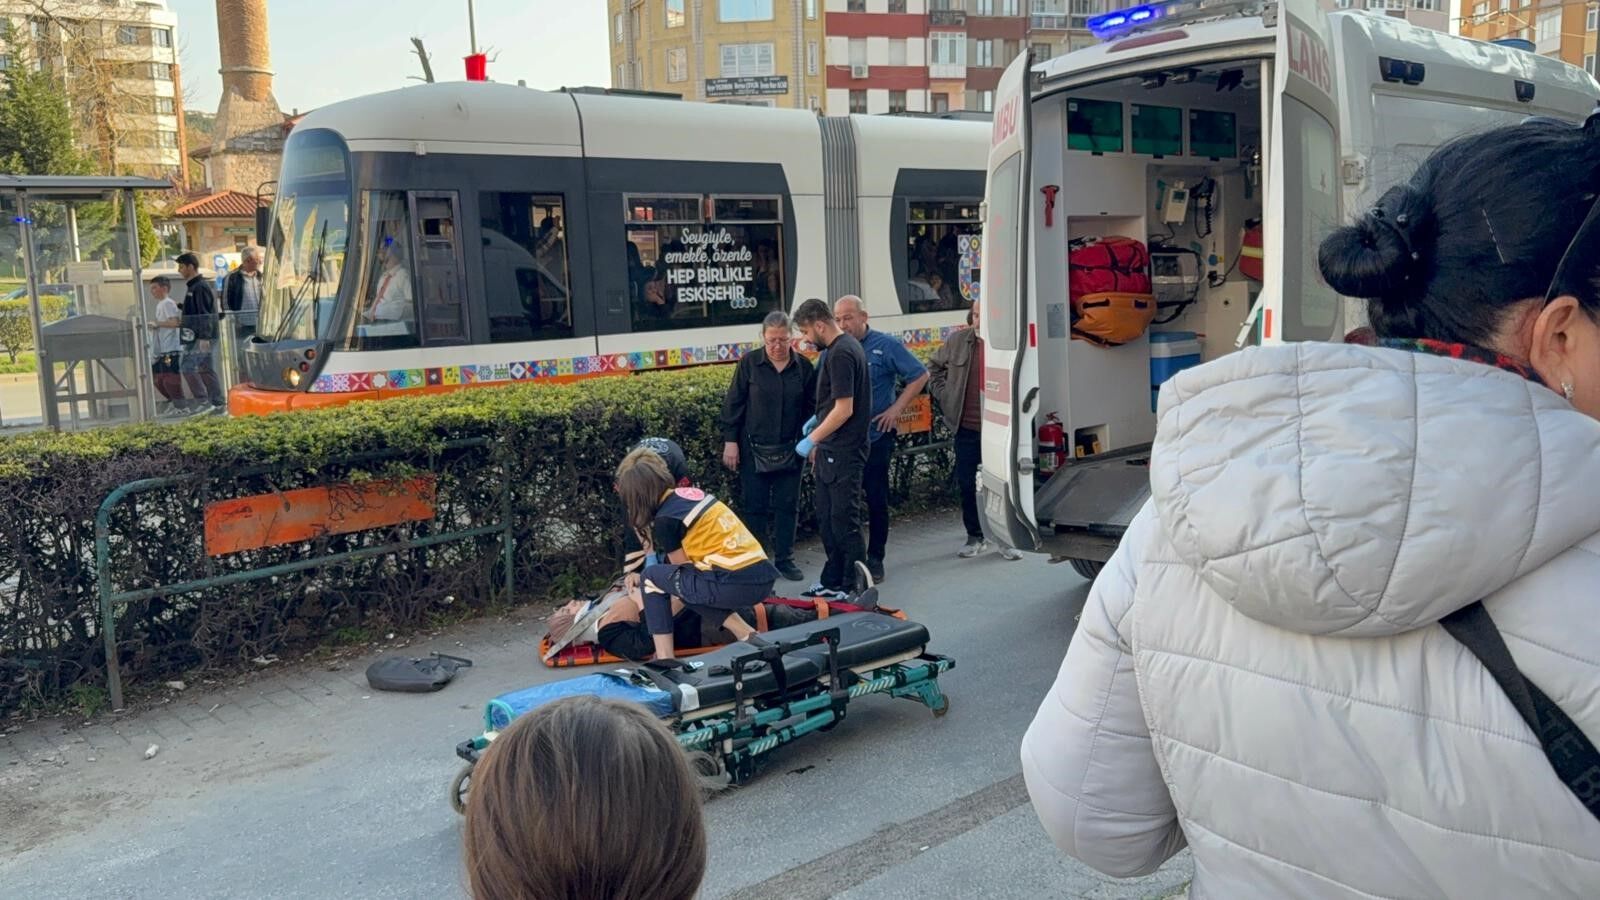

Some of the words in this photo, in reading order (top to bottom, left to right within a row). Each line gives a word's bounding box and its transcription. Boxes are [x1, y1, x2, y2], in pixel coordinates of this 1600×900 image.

[1286, 22, 1332, 94] LANS
[680, 227, 735, 249] Sevgiyle,
[665, 247, 711, 264] emekle,
[712, 245, 752, 262] özenle
[667, 268, 695, 284] HEP
[697, 264, 753, 283] BİRLİKLE
[677, 282, 745, 304] ESKİŞEHİR
